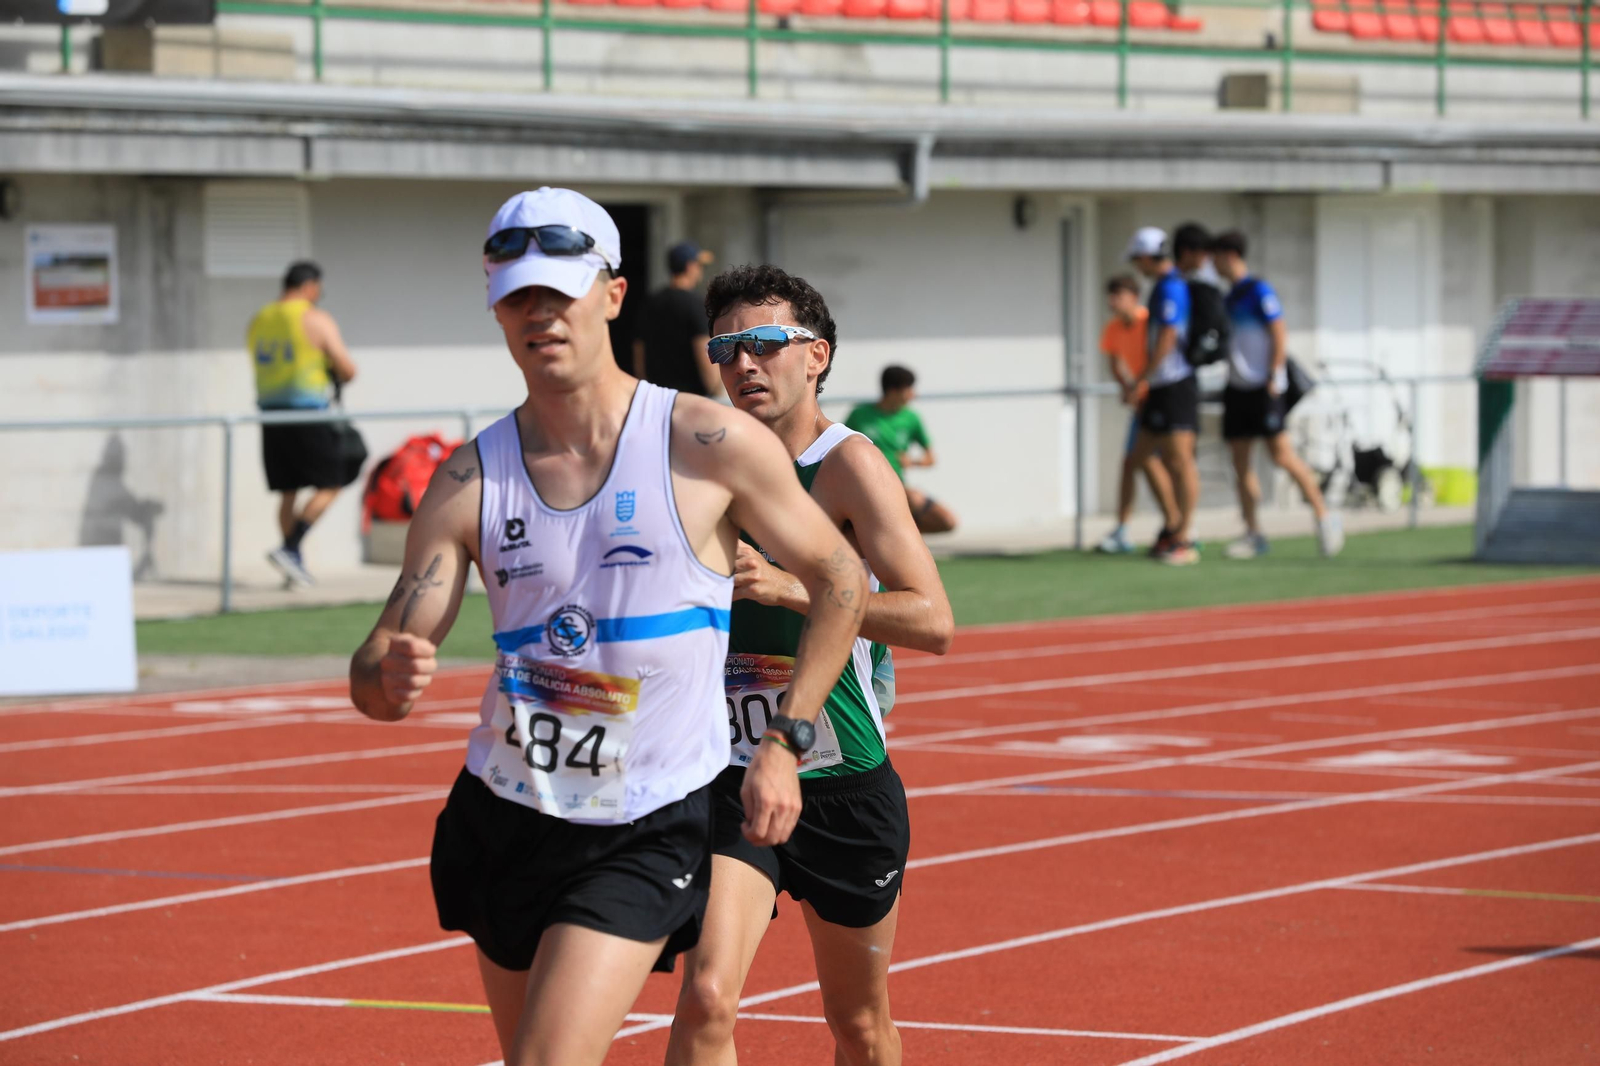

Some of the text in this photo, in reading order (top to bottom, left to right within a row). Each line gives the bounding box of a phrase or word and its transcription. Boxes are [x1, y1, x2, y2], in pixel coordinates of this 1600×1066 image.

[516, 670, 531, 683] DE
[532, 675, 572, 693] GALICIA
[573, 685, 632, 705] ABSOLUTO
